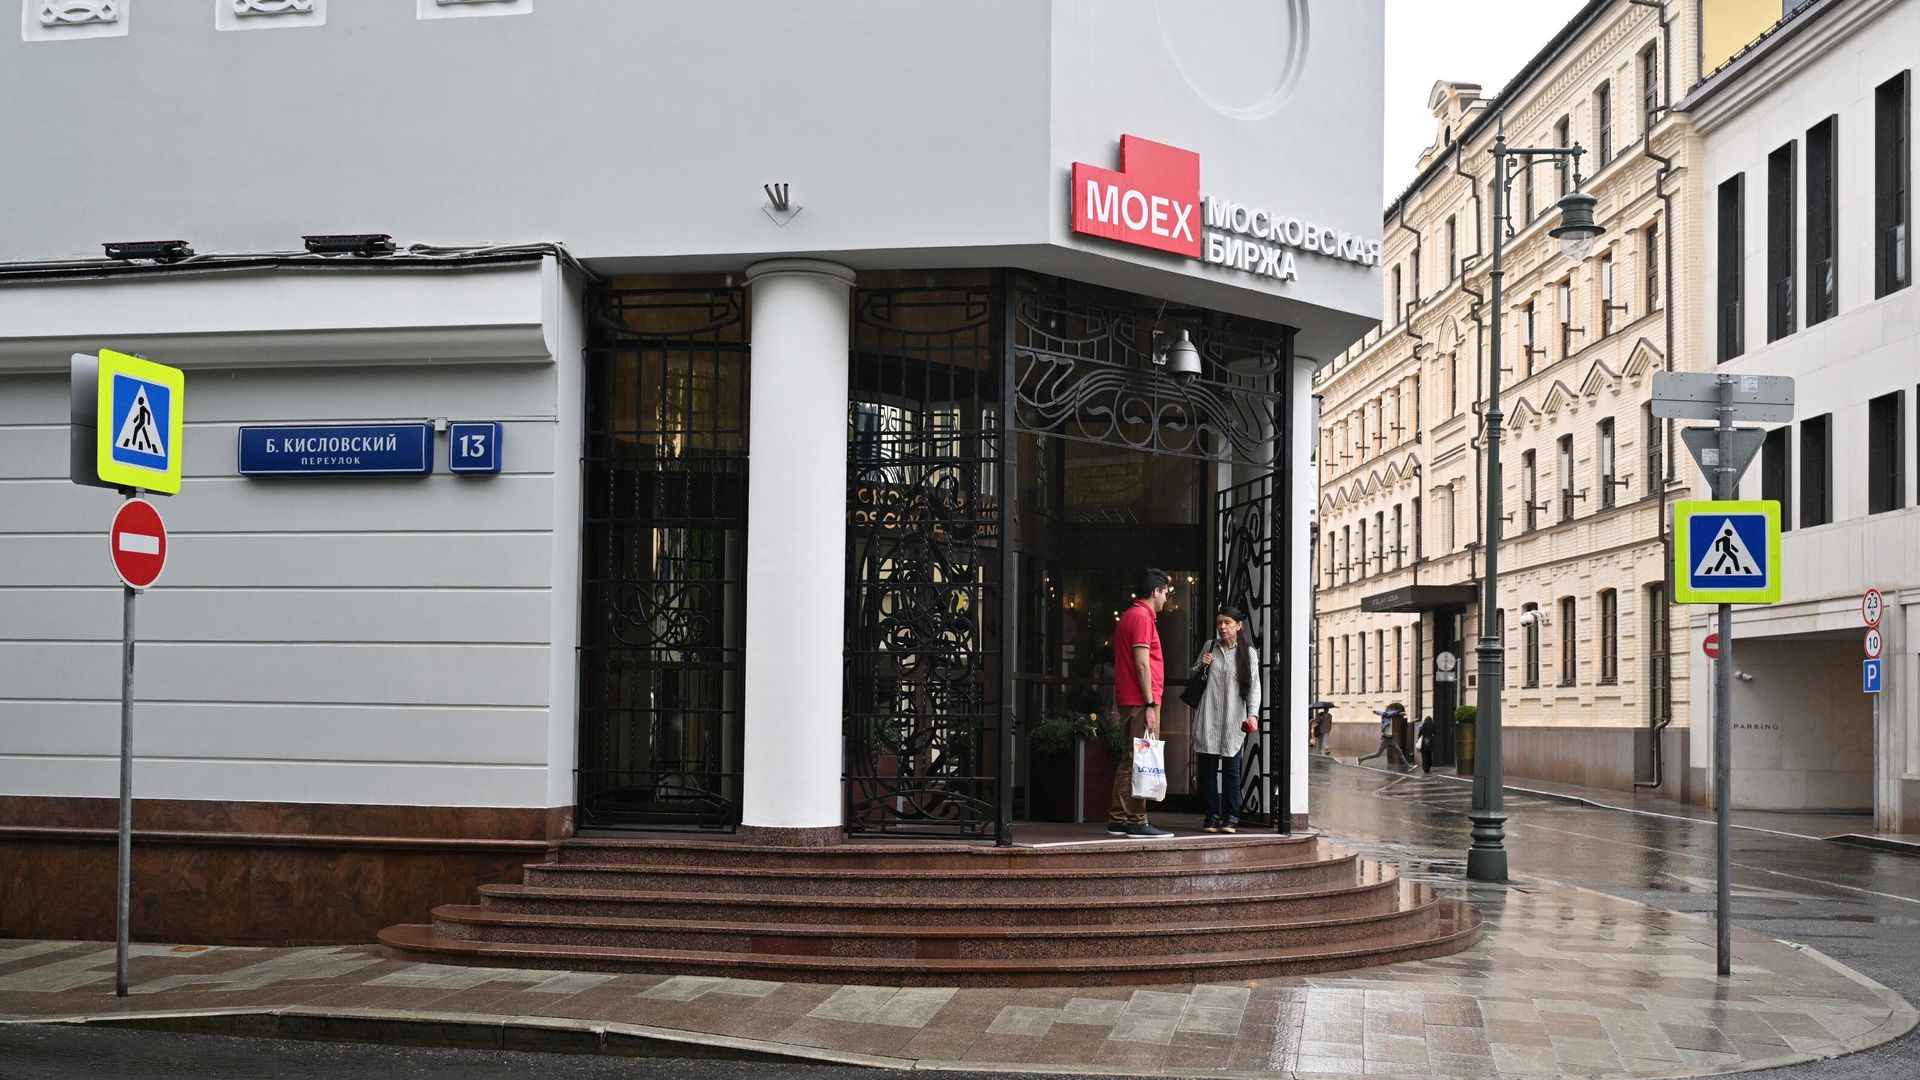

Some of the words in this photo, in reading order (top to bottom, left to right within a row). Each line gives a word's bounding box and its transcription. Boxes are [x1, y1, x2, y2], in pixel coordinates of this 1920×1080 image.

[1086, 179, 1194, 242] MOEX
[1205, 195, 1383, 267] МОСКОВСКАЯ
[1206, 232, 1298, 282] БИРЖА
[266, 438, 279, 453] Б.
[284, 433, 397, 453] КИСЛОВСКИЙ
[459, 434, 486, 458] 13
[301, 456, 361, 465] ПЕРЕУЛОК
[1868, 636, 1879, 650] 10
[1867, 664, 1877, 688] P
